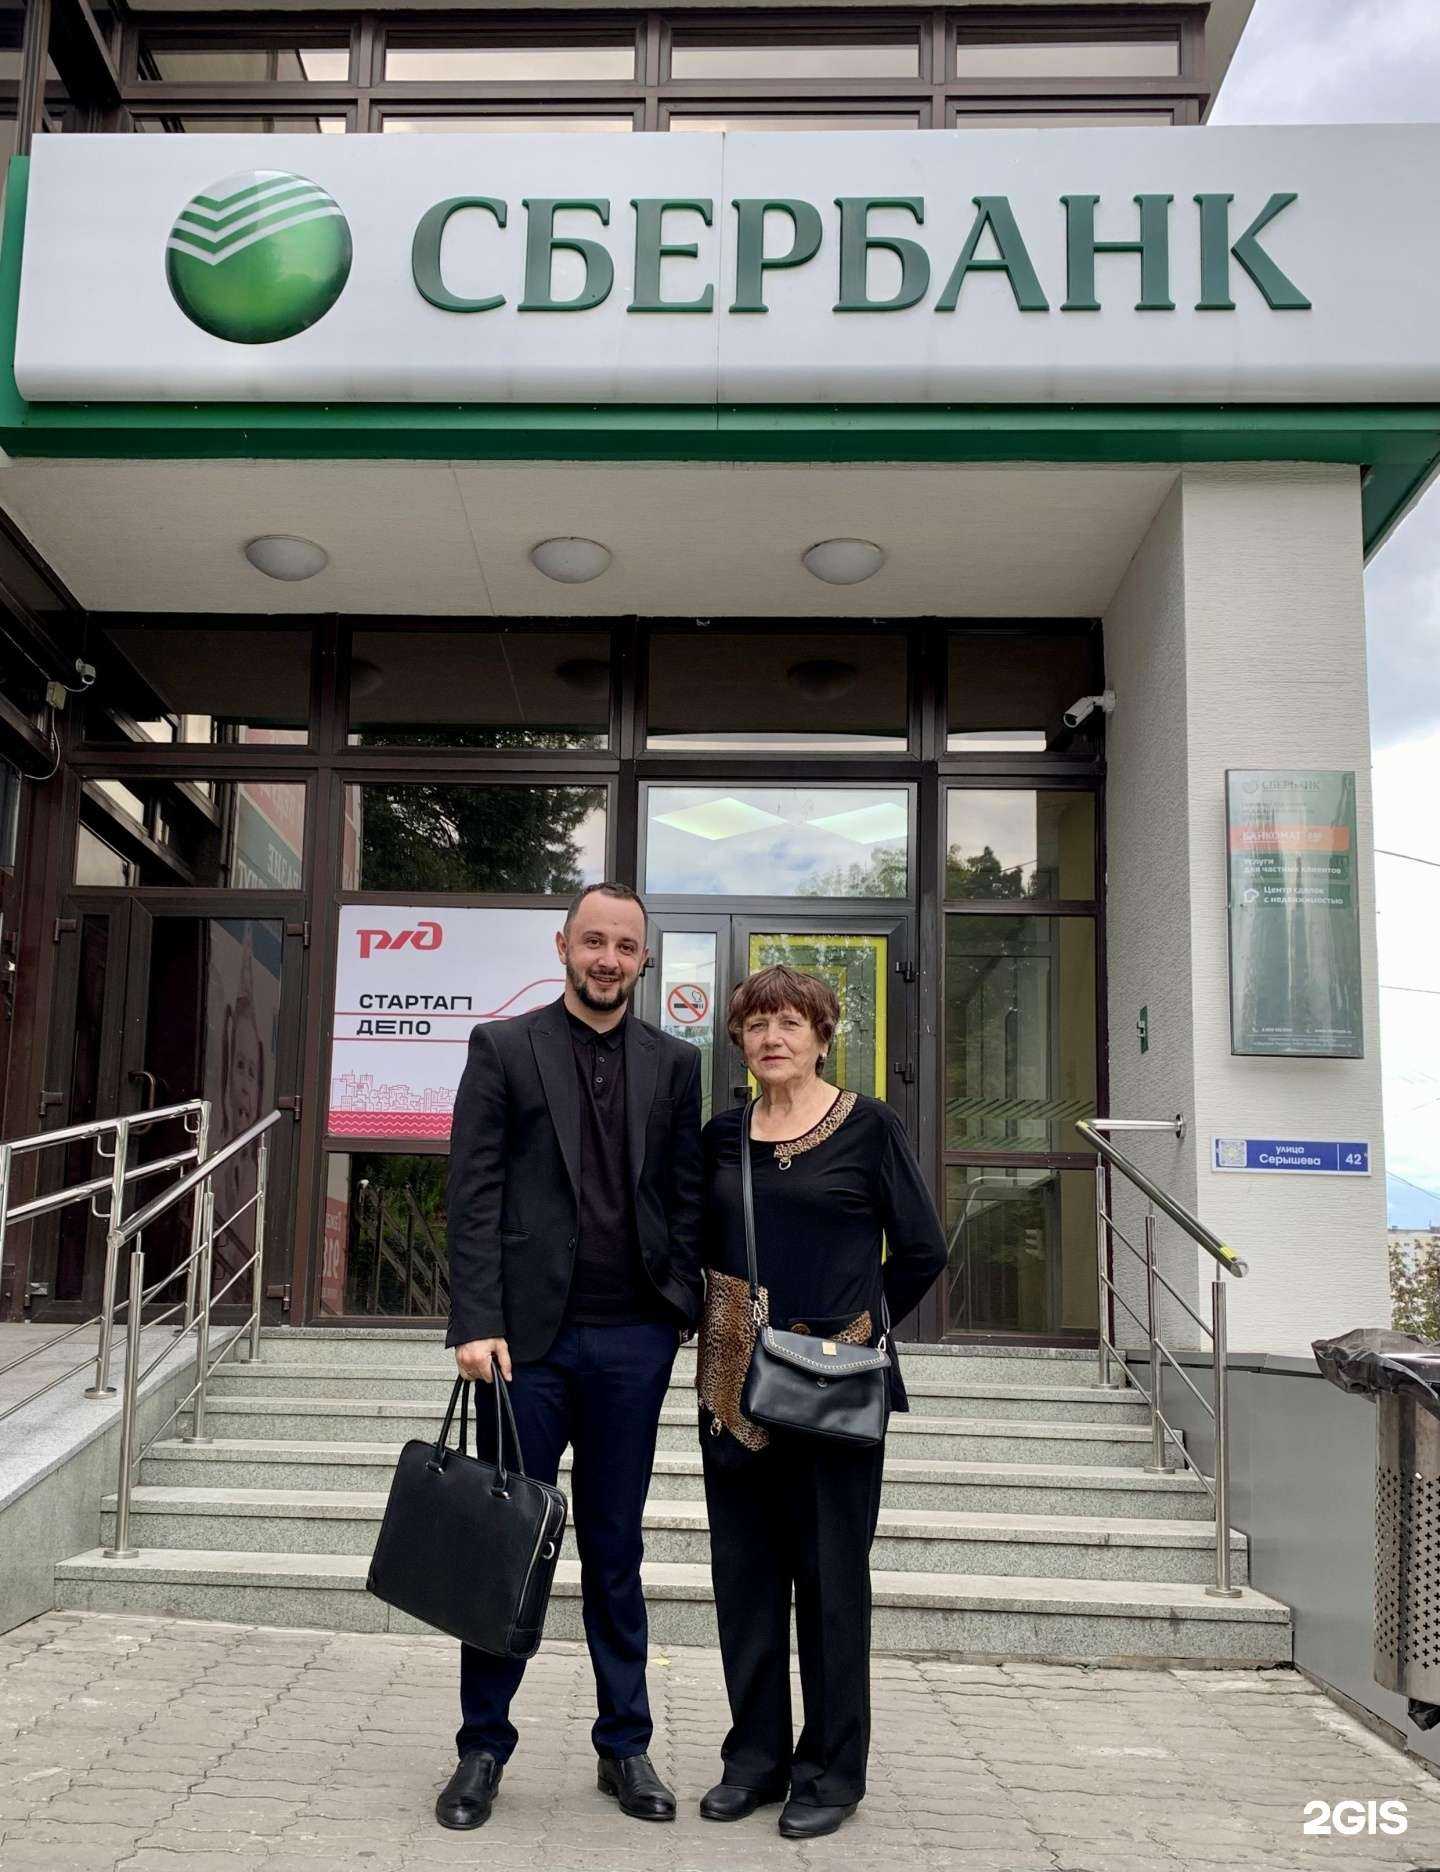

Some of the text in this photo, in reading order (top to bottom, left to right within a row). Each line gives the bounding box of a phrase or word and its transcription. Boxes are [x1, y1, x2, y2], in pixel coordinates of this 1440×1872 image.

[412, 193, 1311, 314] СБЕРБАНК
[359, 994, 473, 1011] СТАРТАП
[356, 1019, 432, 1036] ДЕПО
[1275, 1145, 1305, 1155] улица
[1259, 1153, 1362, 1167] Серышева 42
